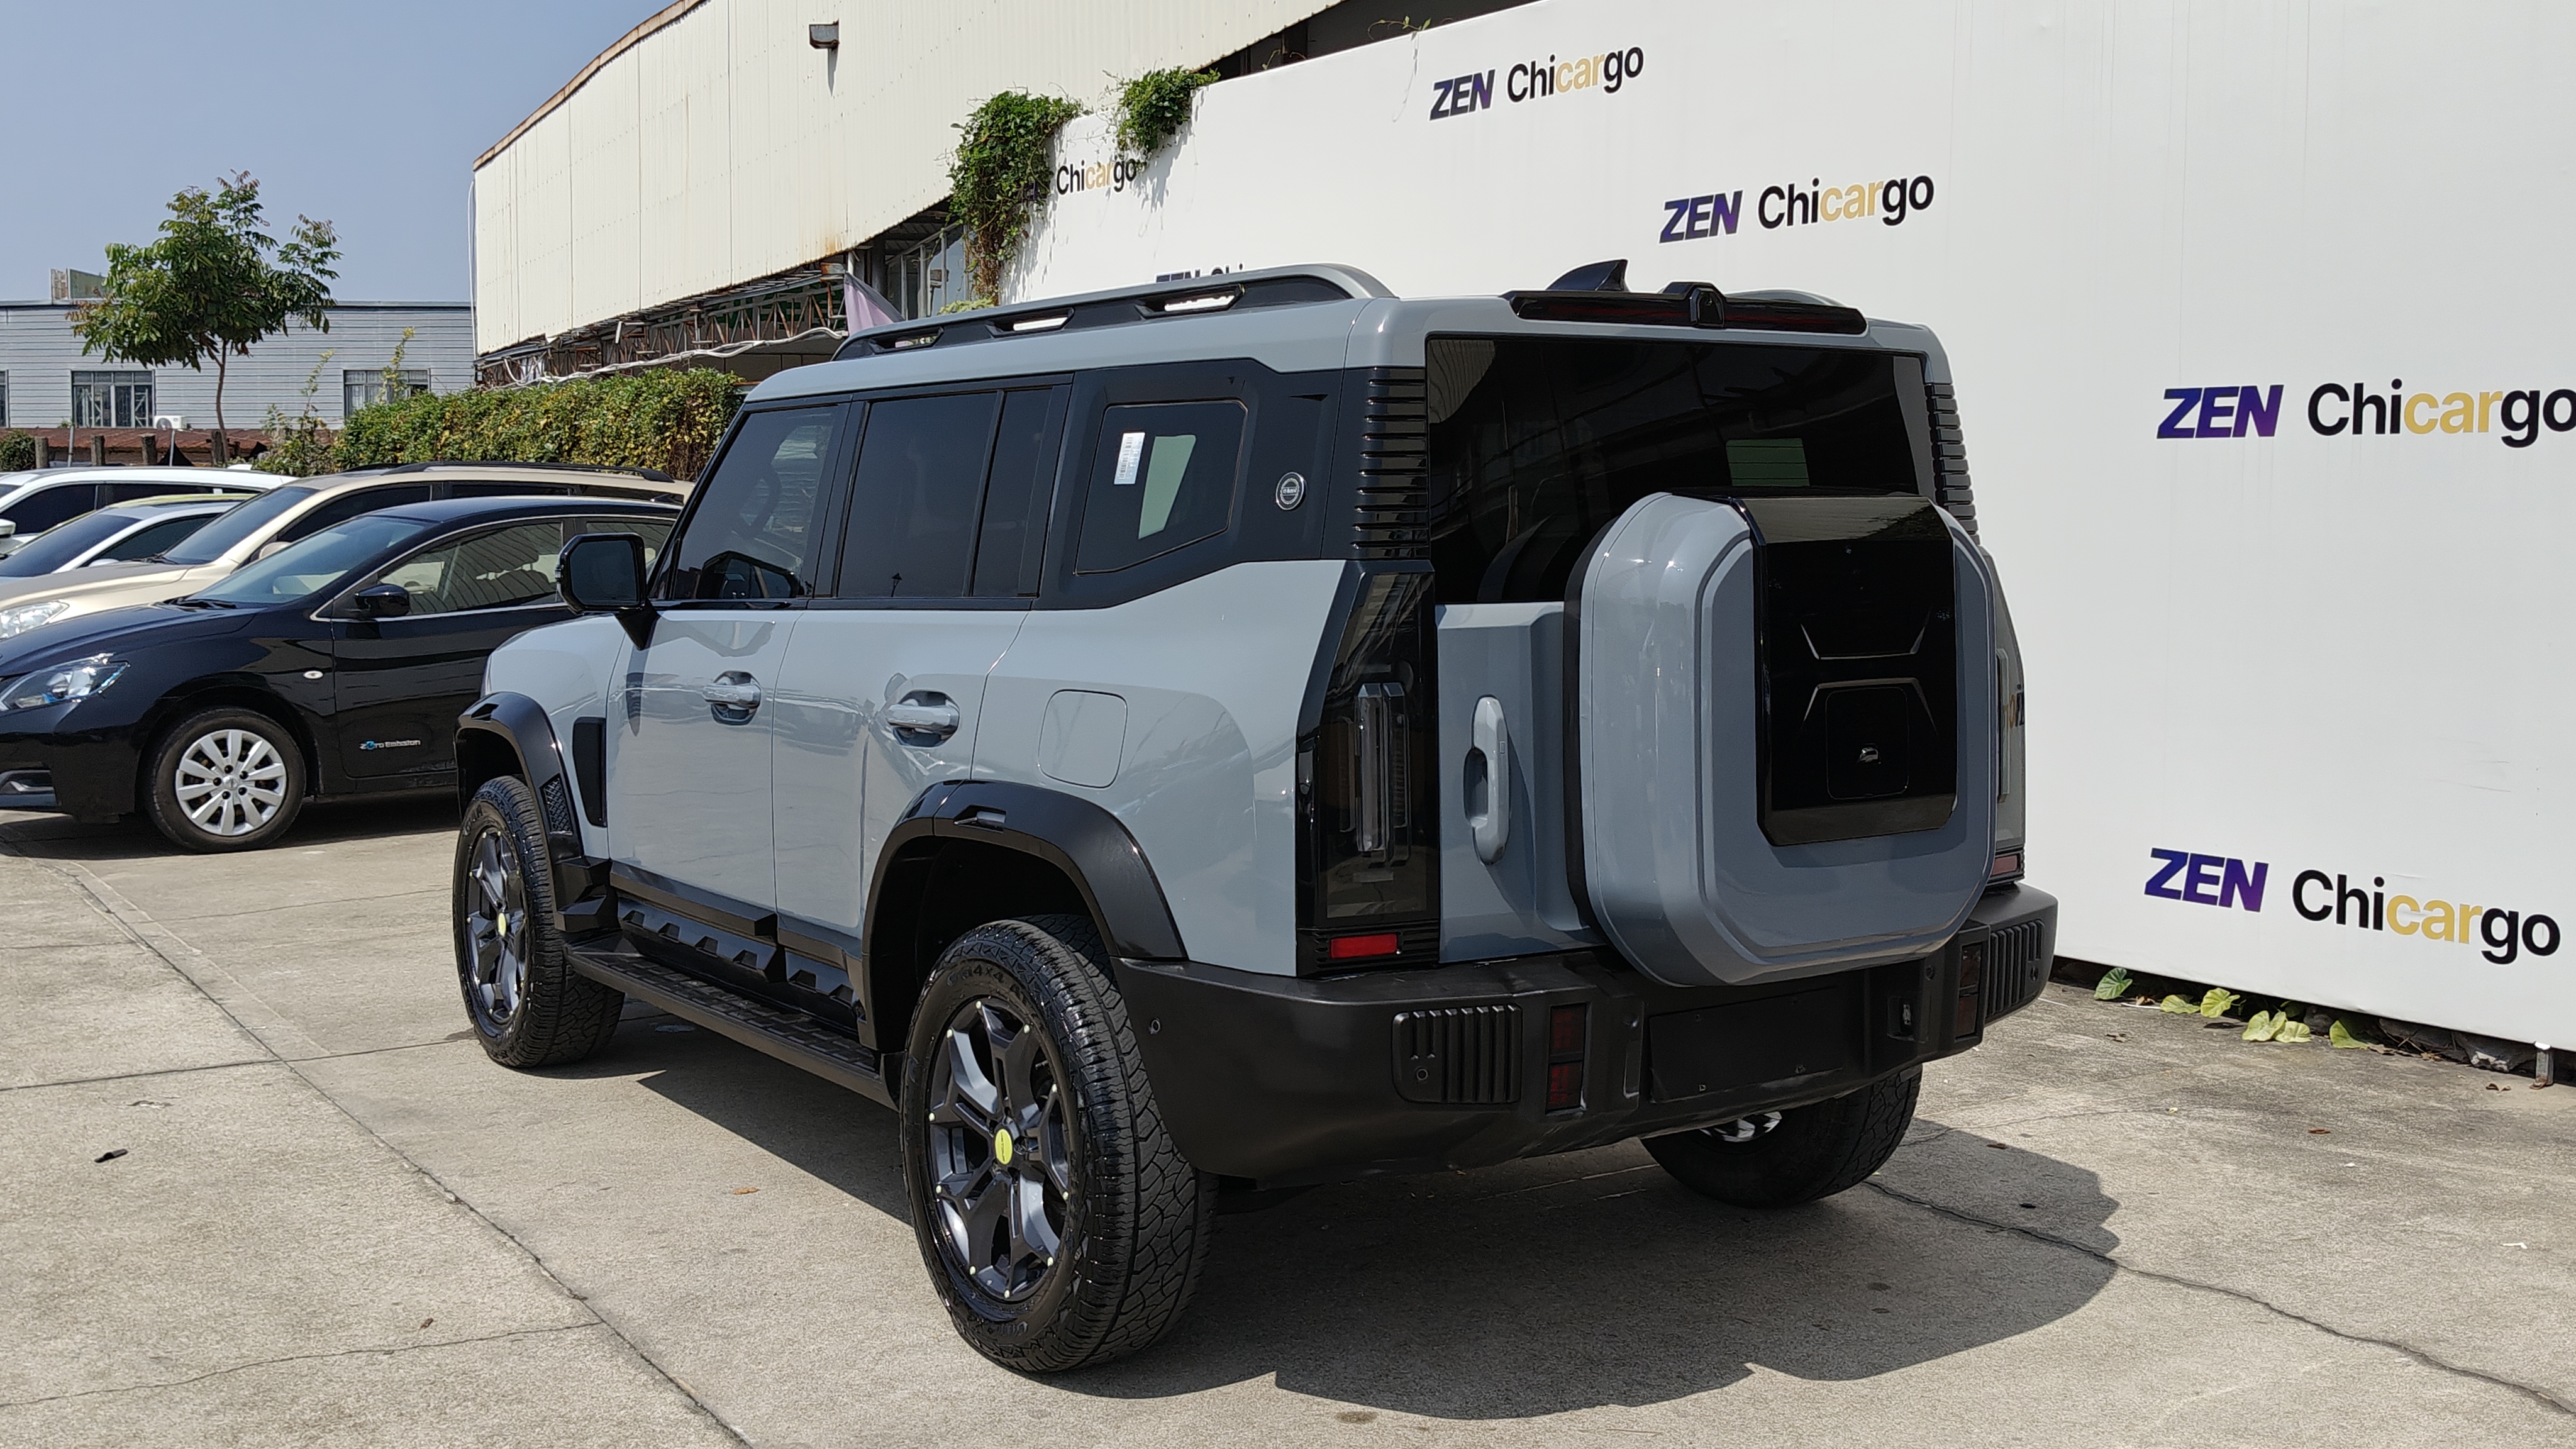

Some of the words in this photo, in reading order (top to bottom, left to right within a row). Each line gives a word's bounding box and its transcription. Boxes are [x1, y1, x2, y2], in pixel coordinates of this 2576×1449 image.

[1430, 69, 1496, 120] ZEN
[1507, 47, 1644, 103] Chicargo
[1057, 158, 1137, 195] Chicargo
[1659, 191, 1743, 243] ZEN
[1758, 175, 1935, 229] Chicargo
[2156, 384, 2284, 440] ZEN
[2307, 378, 2576, 448] Chicargo
[2143, 847, 2269, 913] ZEN
[2292, 869, 2562, 965] Chicargo
